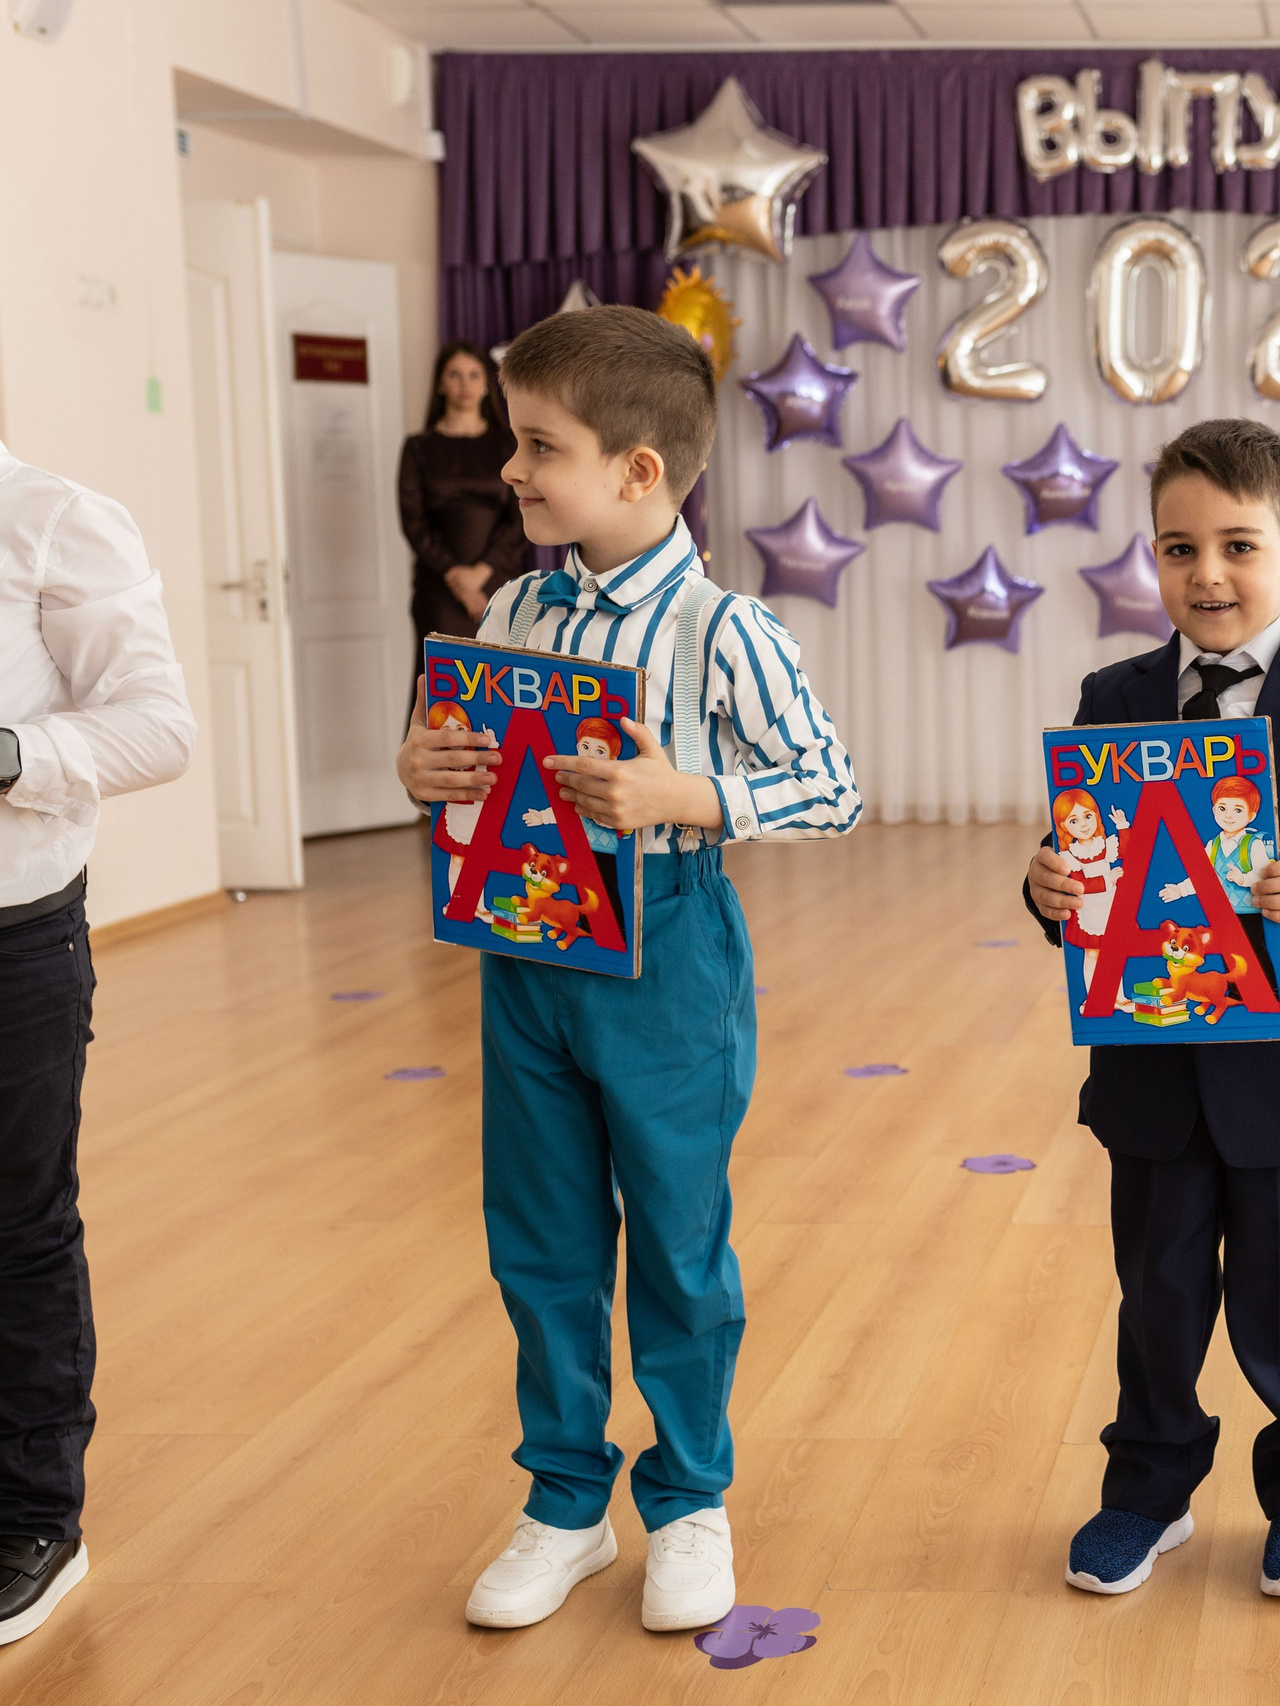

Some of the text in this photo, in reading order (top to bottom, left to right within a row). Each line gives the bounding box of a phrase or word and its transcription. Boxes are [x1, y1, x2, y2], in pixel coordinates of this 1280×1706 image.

[427, 657, 630, 720] БУКВАРЬ
[1050, 734, 1267, 787] БУКВАРЬ
[444, 707, 628, 954] А
